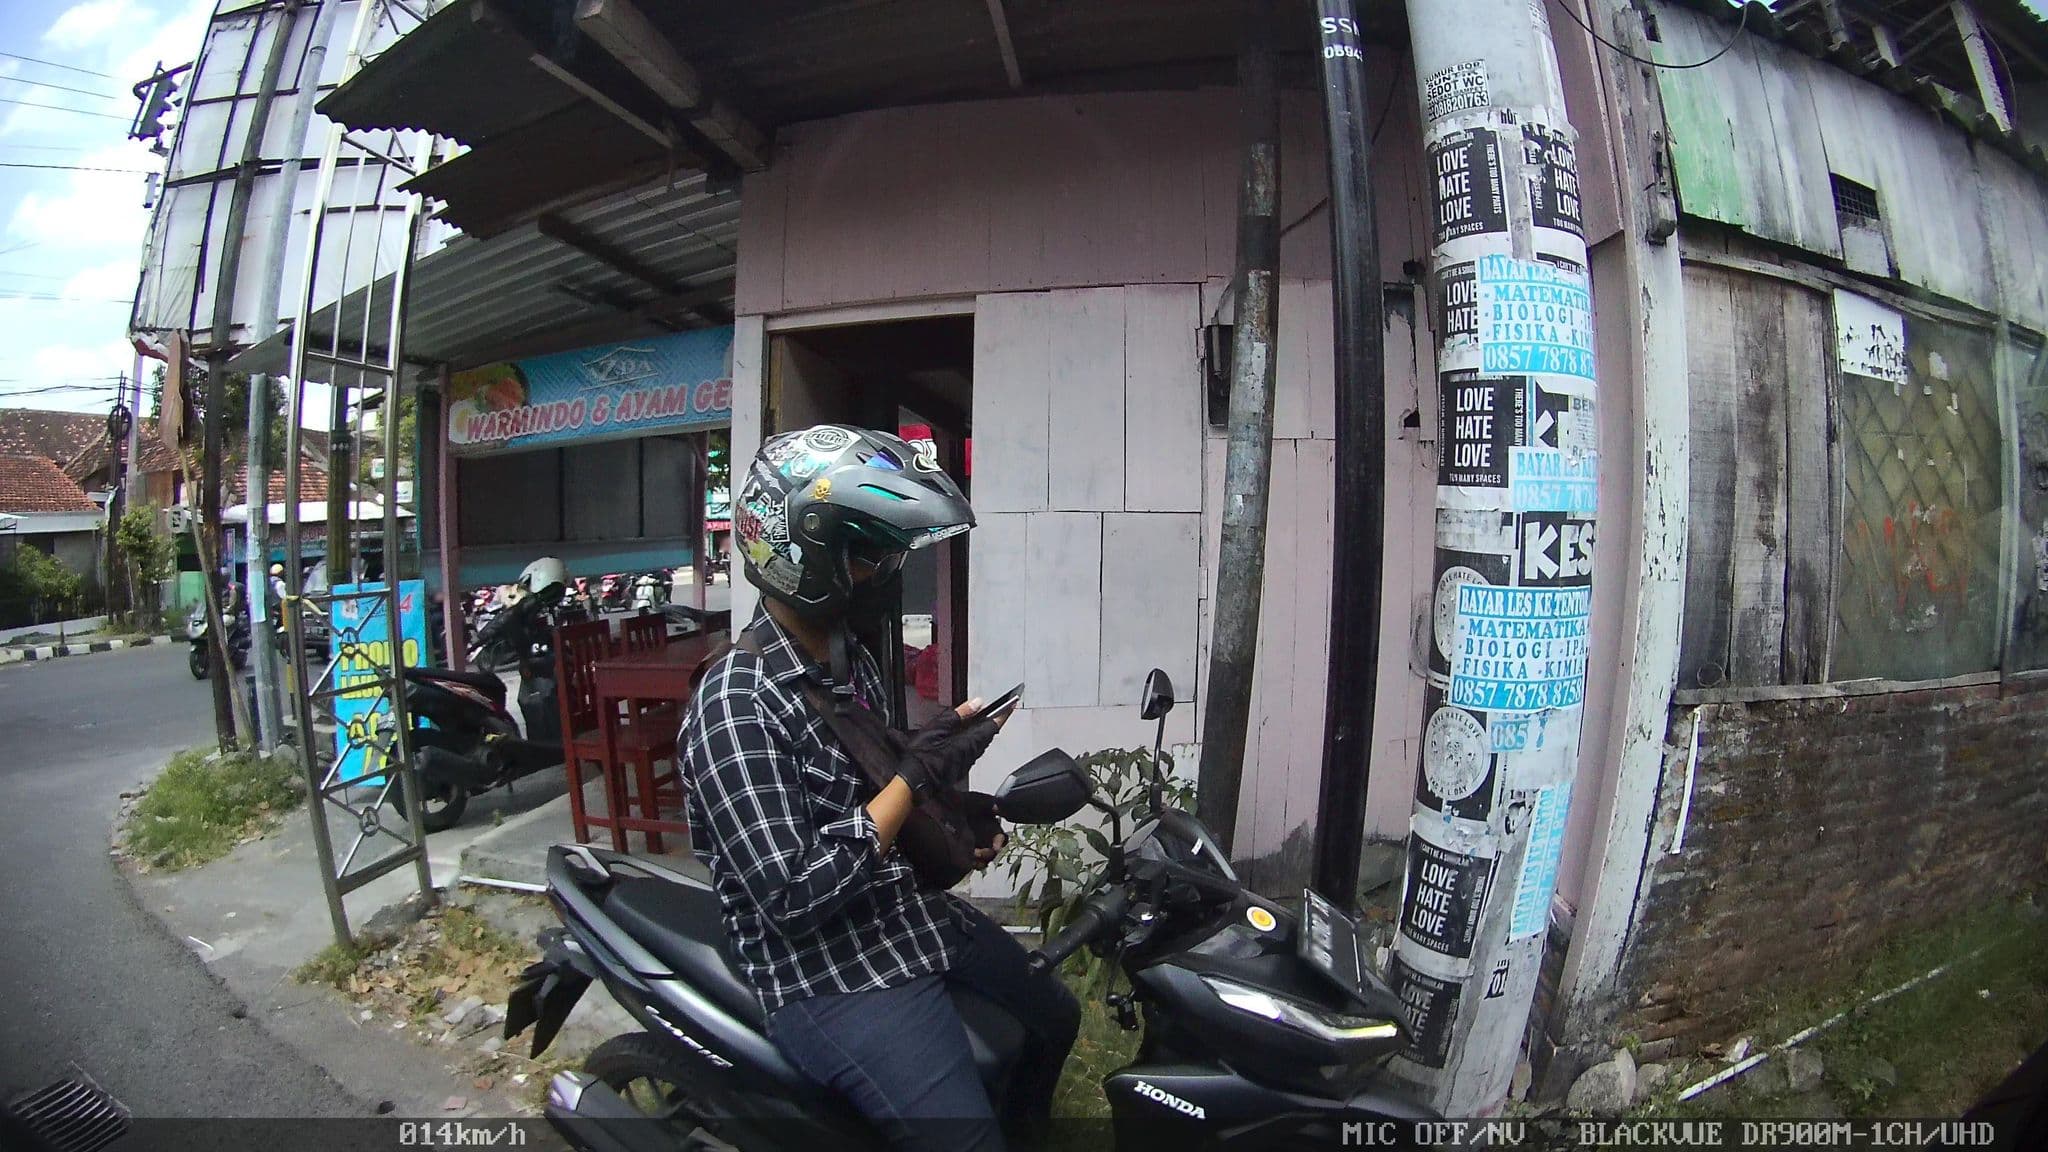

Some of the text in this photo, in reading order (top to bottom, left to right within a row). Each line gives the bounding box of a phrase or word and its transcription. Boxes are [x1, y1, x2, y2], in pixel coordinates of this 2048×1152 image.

[1463, 76, 1484, 88] WC
[1437, 147, 1469, 177] LOVE
[1554, 168, 1579, 197] HATE
[1440, 196, 1473, 225] LOVE
[1492, 195, 1502, 214] PARTS
[1556, 192, 1581, 221] LOVE
[1460, 221, 1484, 235] SPACES
[1446, 280, 1477, 307] LOVE
[1447, 306, 1478, 333] HATE
[1493, 304, 1574, 326] BIOLOGI
[1493, 323, 1559, 343] FISIKA
[1486, 345, 1532, 370] 0857
[1540, 347, 1579, 373] 7878
[467, 377, 732, 442] WARMINDO & AYAM GE
[1456, 387, 1495, 412] LOVE
[1514, 388, 1524, 413] THERE'S
[1455, 415, 1494, 440] HATE
[1514, 415, 1524, 427] TOO
[1454, 443, 1491, 468] LOVE
[1517, 452, 1560, 477] BAYAR
[1476, 473, 1501, 484] SPACES
[1461, 588, 1505, 615] BAYAR
[1507, 590, 1533, 617] LES
[1534, 592, 1553, 618] KE
[1468, 618, 1586, 640] MATEMATIKA
[1465, 638, 1552, 659] BIOLOGI
[1462, 657, 1583, 680] FISIKA KIMIA
[1453, 679, 1581, 708] 0857 7878 8758
[1445, 711, 1462, 722] HATE
[1421, 859, 1459, 892] LOVE
[1416, 881, 1453, 915] HATE
[1411, 905, 1448, 937] LOVE
[1133, 1080, 1206, 1120] HONDA
